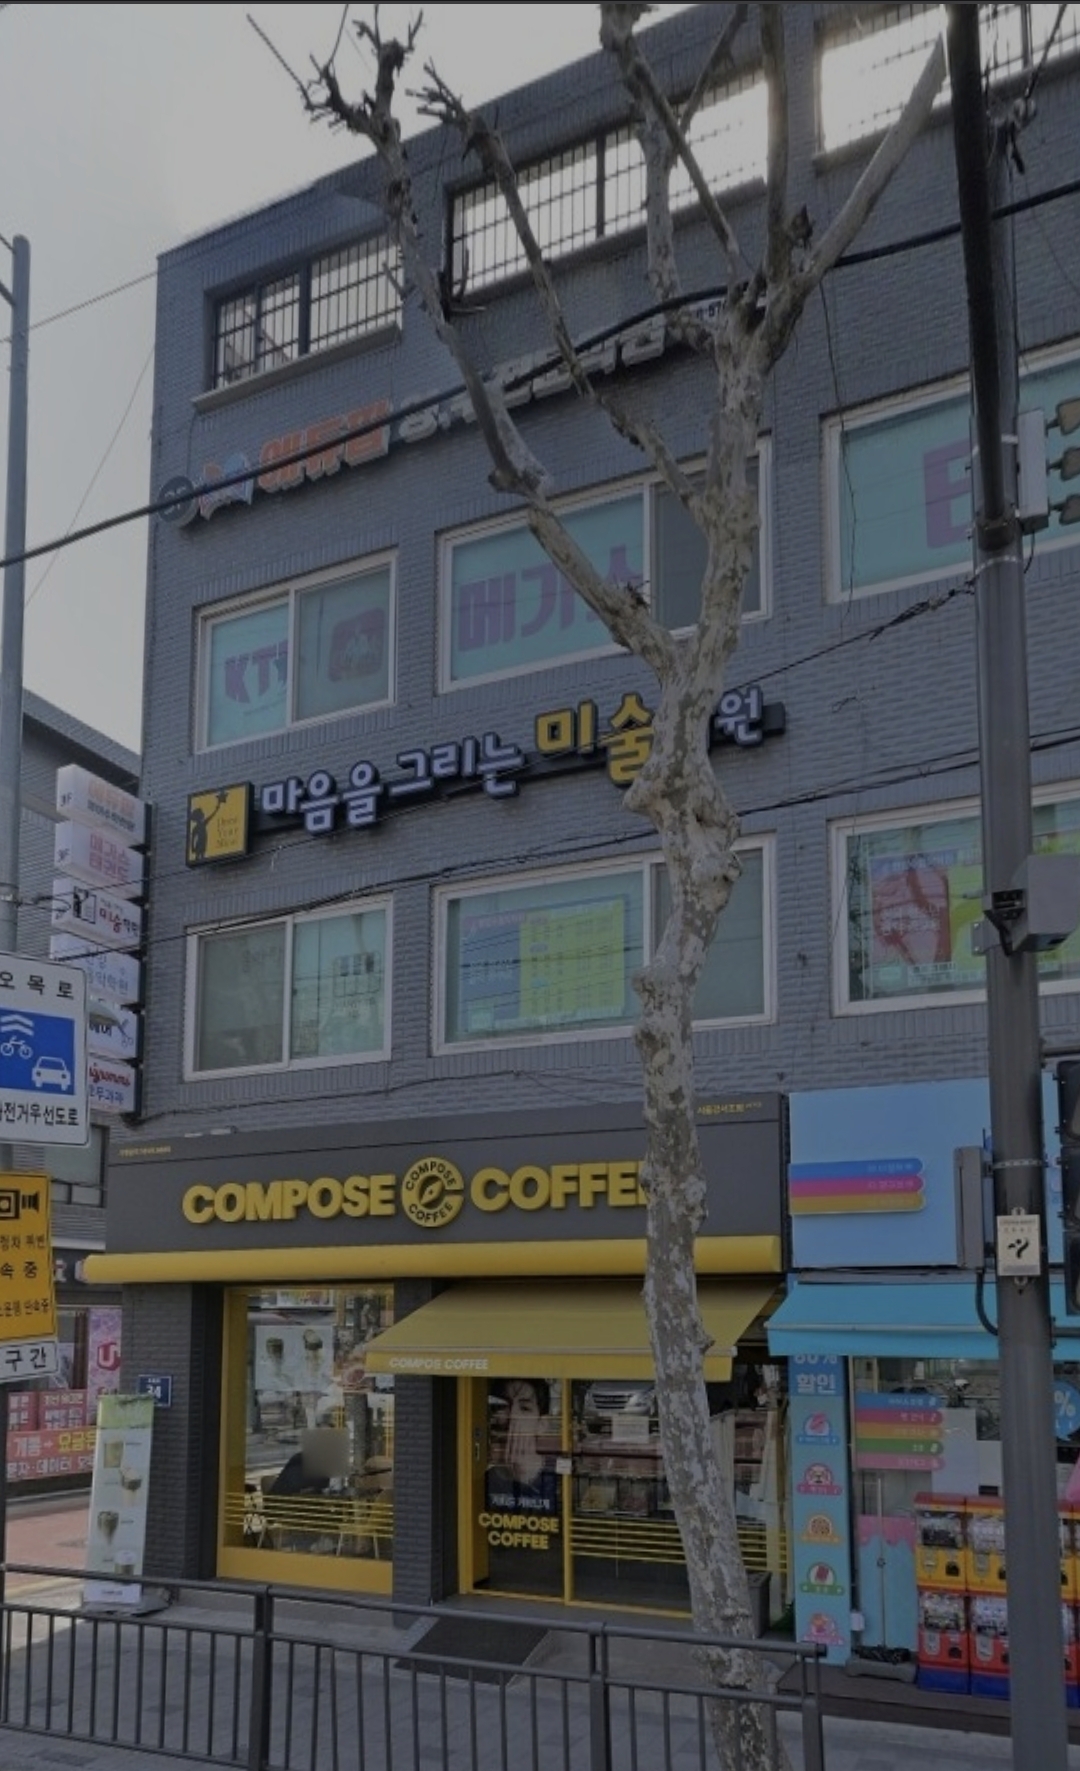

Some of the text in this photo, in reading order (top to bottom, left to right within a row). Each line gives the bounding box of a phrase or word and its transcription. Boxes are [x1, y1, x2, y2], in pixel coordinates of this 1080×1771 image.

[261, 687, 764, 834] 마음을 그리는 미술원
[0, 1102, 78, 1126] 전거우선도로
[406, 1161, 457, 1191] COMPOSE
[182, 1174, 396, 1223] COMPOSE
[408, 1203, 453, 1223] COFFEE
[444, 1358, 488, 1370] COFFEE
[796, 1373, 837, 1395] 할인
[478, 1513, 559, 1533] COMPOSE
[488, 1530, 549, 1549] COFFEE
